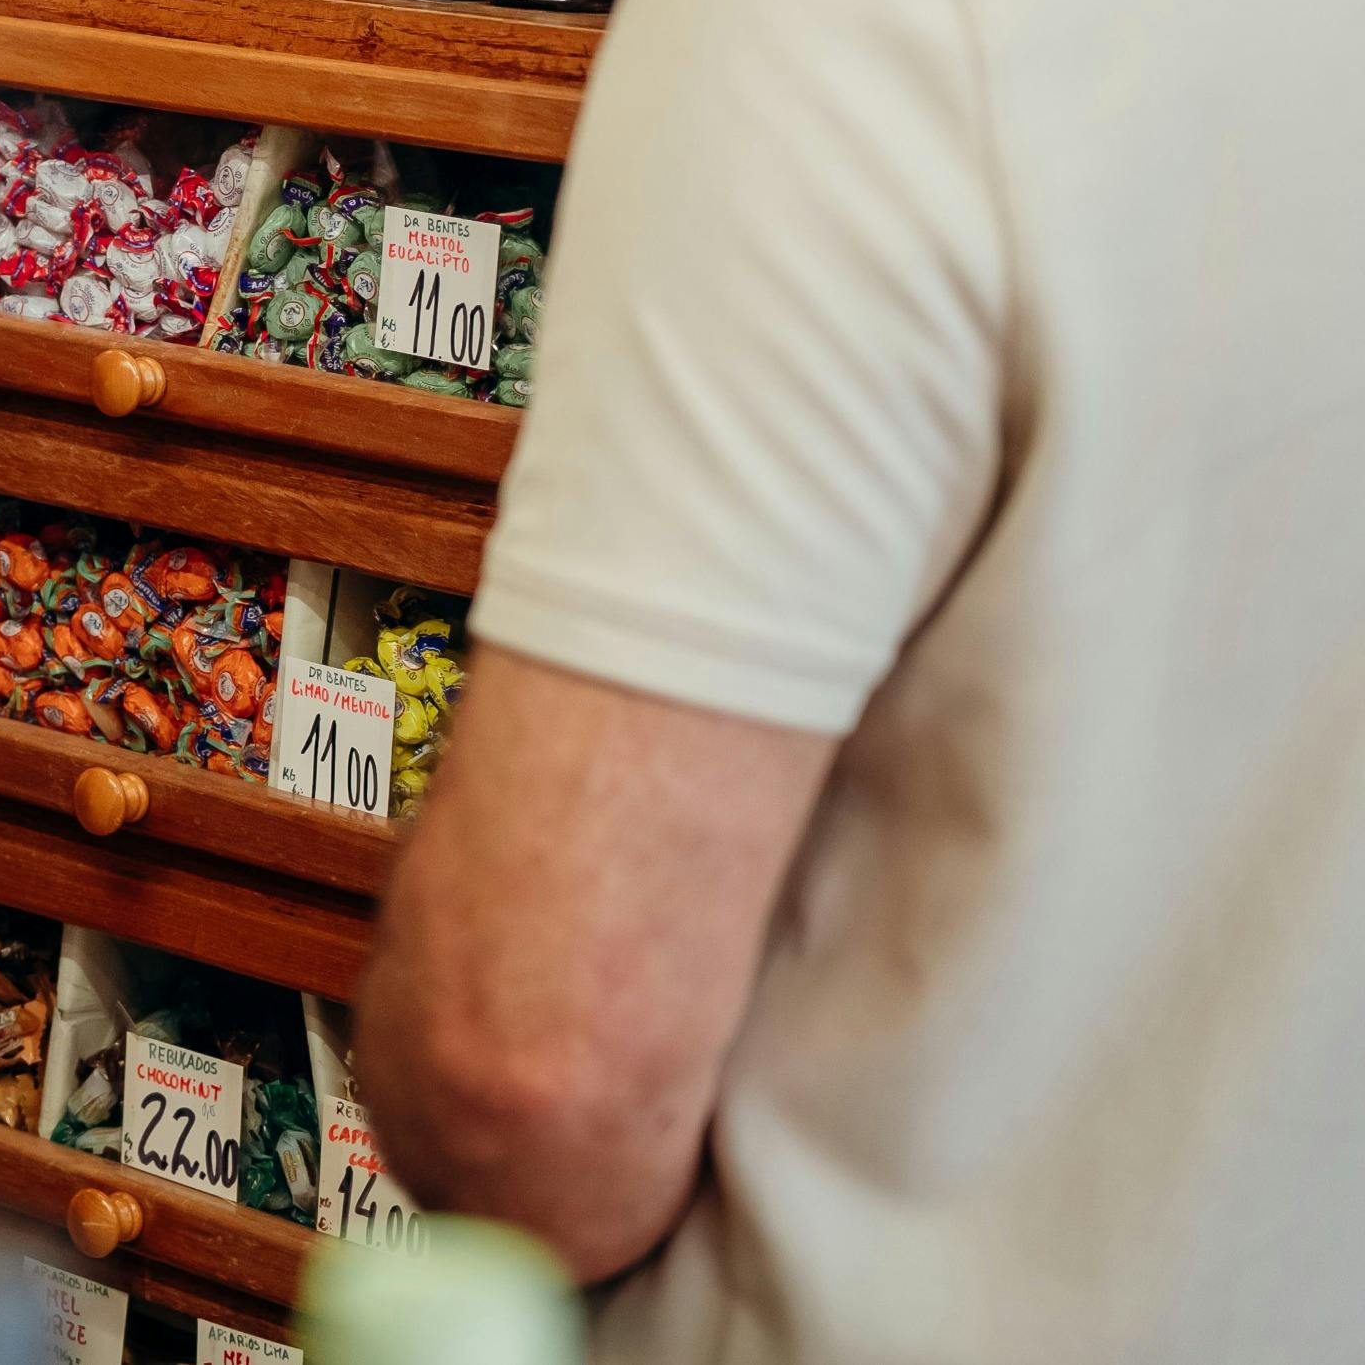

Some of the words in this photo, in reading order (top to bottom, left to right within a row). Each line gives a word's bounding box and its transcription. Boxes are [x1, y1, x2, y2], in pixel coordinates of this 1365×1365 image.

[403, 214, 420, 228] DR
[427, 218, 470, 238] BENTES
[408, 230, 464, 254] MENTOL
[408, 268, 485, 366] 11.00
[309, 666, 322, 681] DR
[326, 669, 367, 693] BENTES
[148, 1042, 218, 1075] REBUÇADOS
[137, 1092, 239, 1188] 22.00
